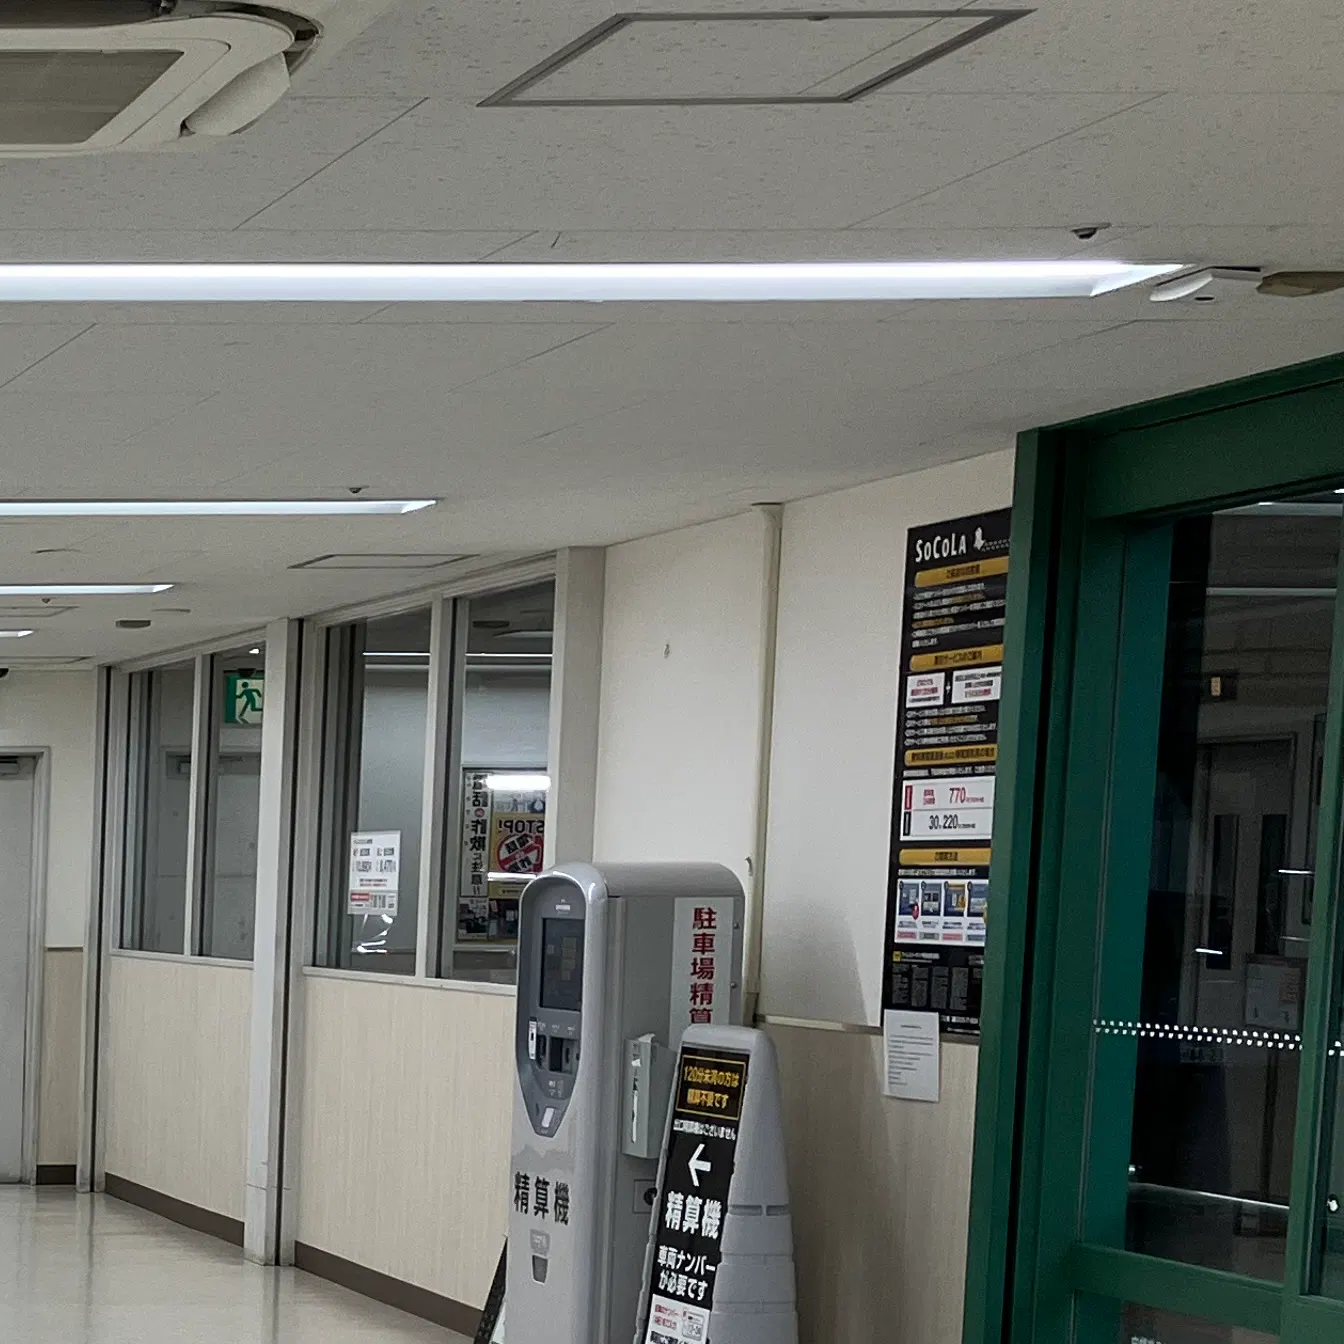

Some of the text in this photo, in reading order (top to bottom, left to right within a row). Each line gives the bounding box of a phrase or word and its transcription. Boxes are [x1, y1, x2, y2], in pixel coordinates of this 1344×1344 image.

[513, 1171, 570, 1226] 精算機
[665, 1190, 723, 1240] 精算機
[657, 1245, 716, 1274] 車両ナンバー
[658, 1271, 709, 1301] が必要です
